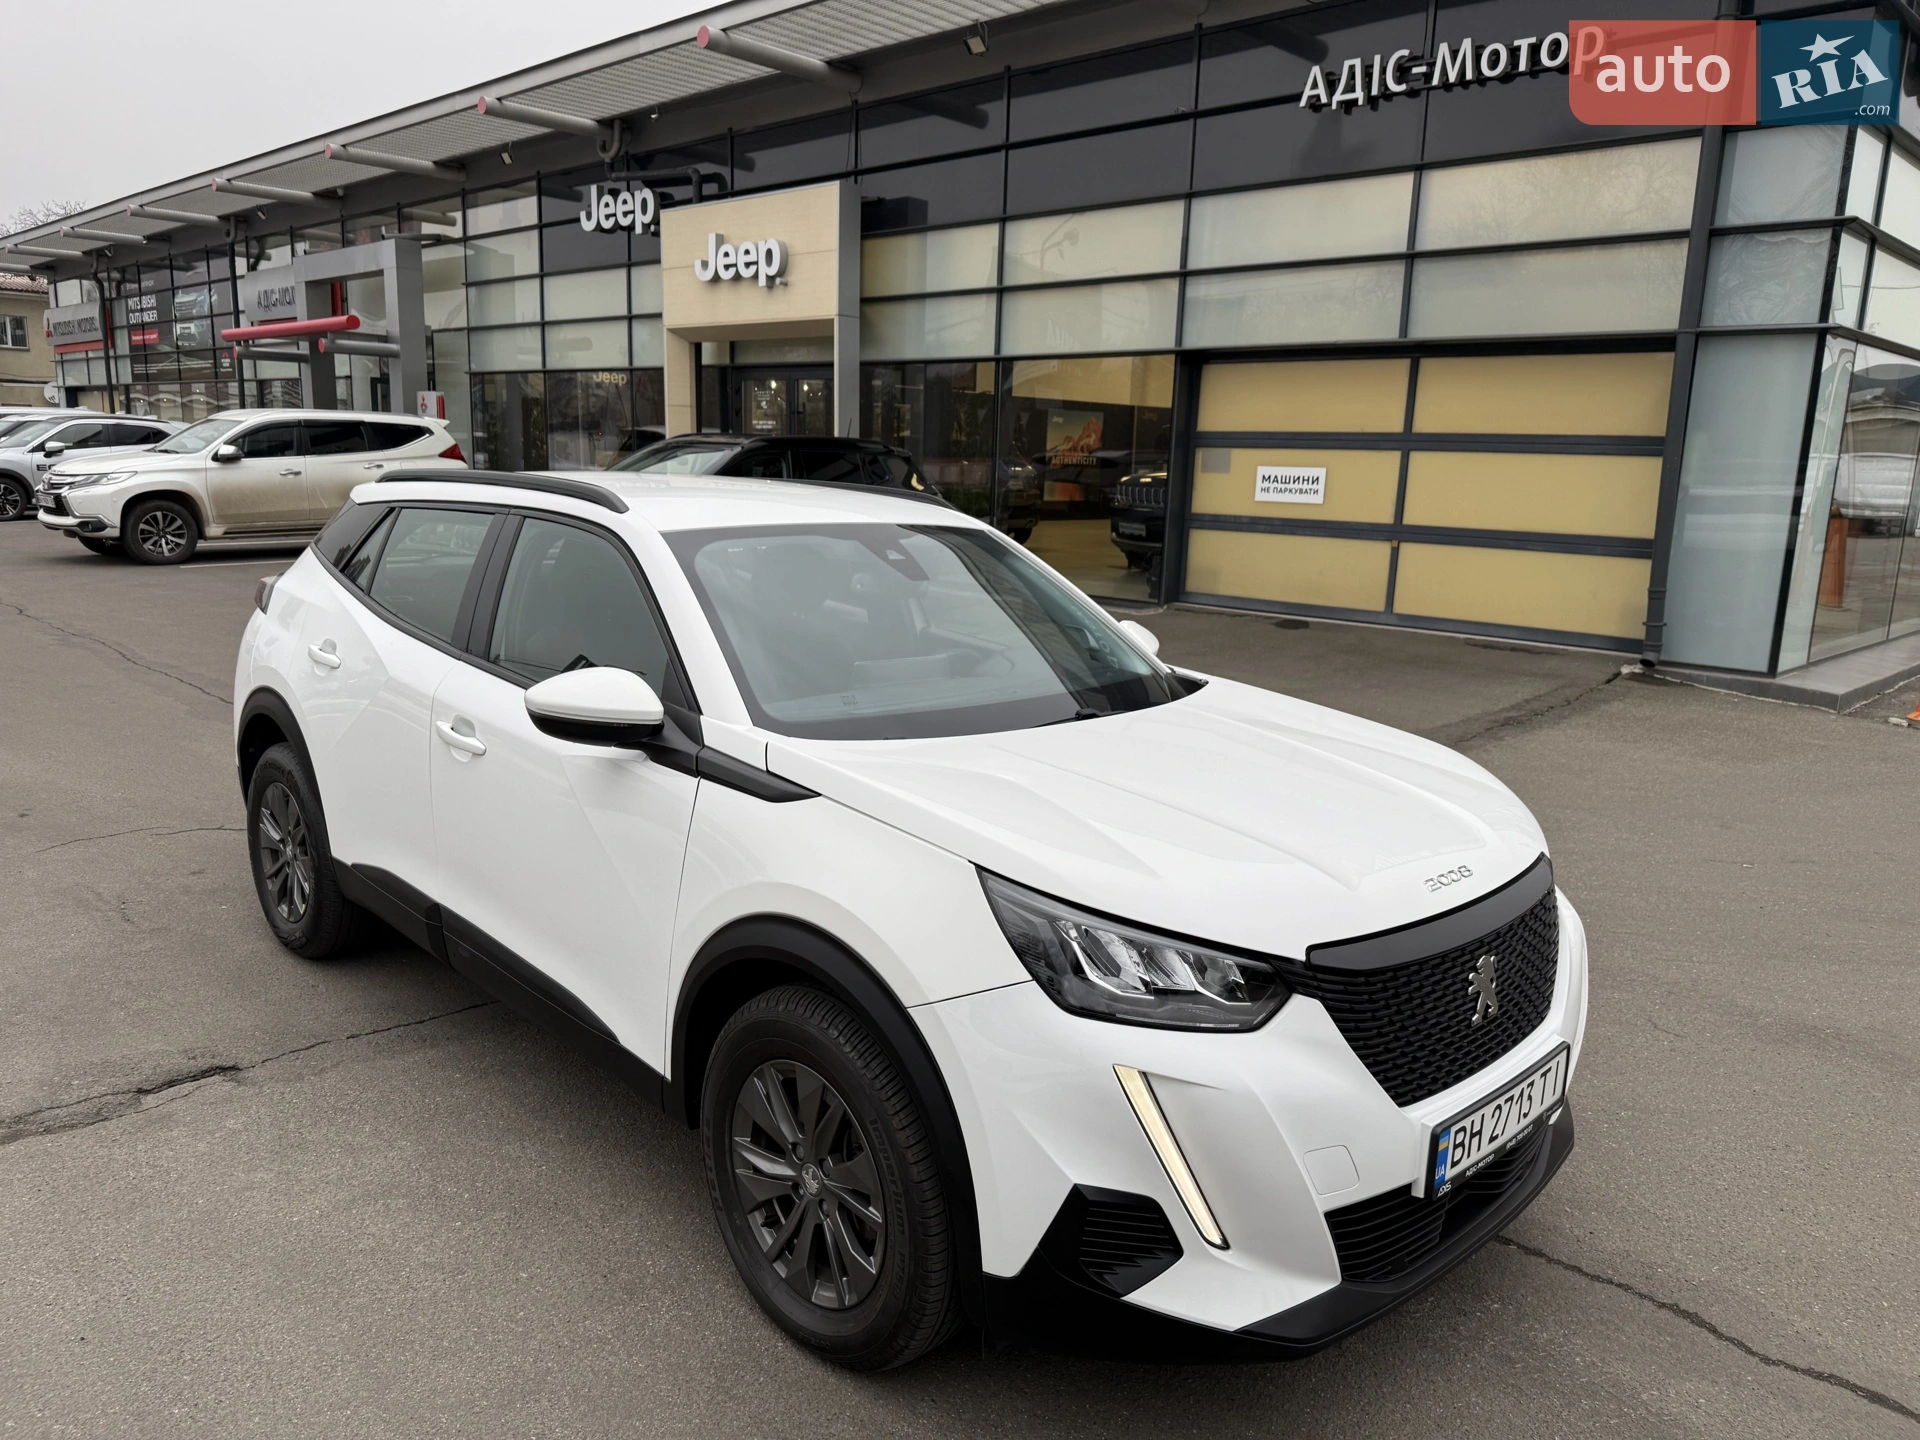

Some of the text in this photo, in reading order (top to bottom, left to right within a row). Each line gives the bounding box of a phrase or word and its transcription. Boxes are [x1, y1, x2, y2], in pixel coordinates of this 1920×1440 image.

[1299, 24, 1606, 110] АДІС-Мотор
[579, 183, 656, 235] Jeep
[694, 231, 788, 288] Jeep
[127, 294, 157, 311] MITSBISHI
[592, 371, 628, 387] Jeep
[1051, 455, 1098, 466] AUTHENTICITY
[1261, 474, 1320, 486] МАШИНИ
[1260, 486, 1319, 496] НЕ ПАРКУВАТИ
[1423, 864, 1473, 893] 2008
[1450, 1060, 1560, 1170] BH 2713 TI
[1435, 1166, 1445, 1179] UA
